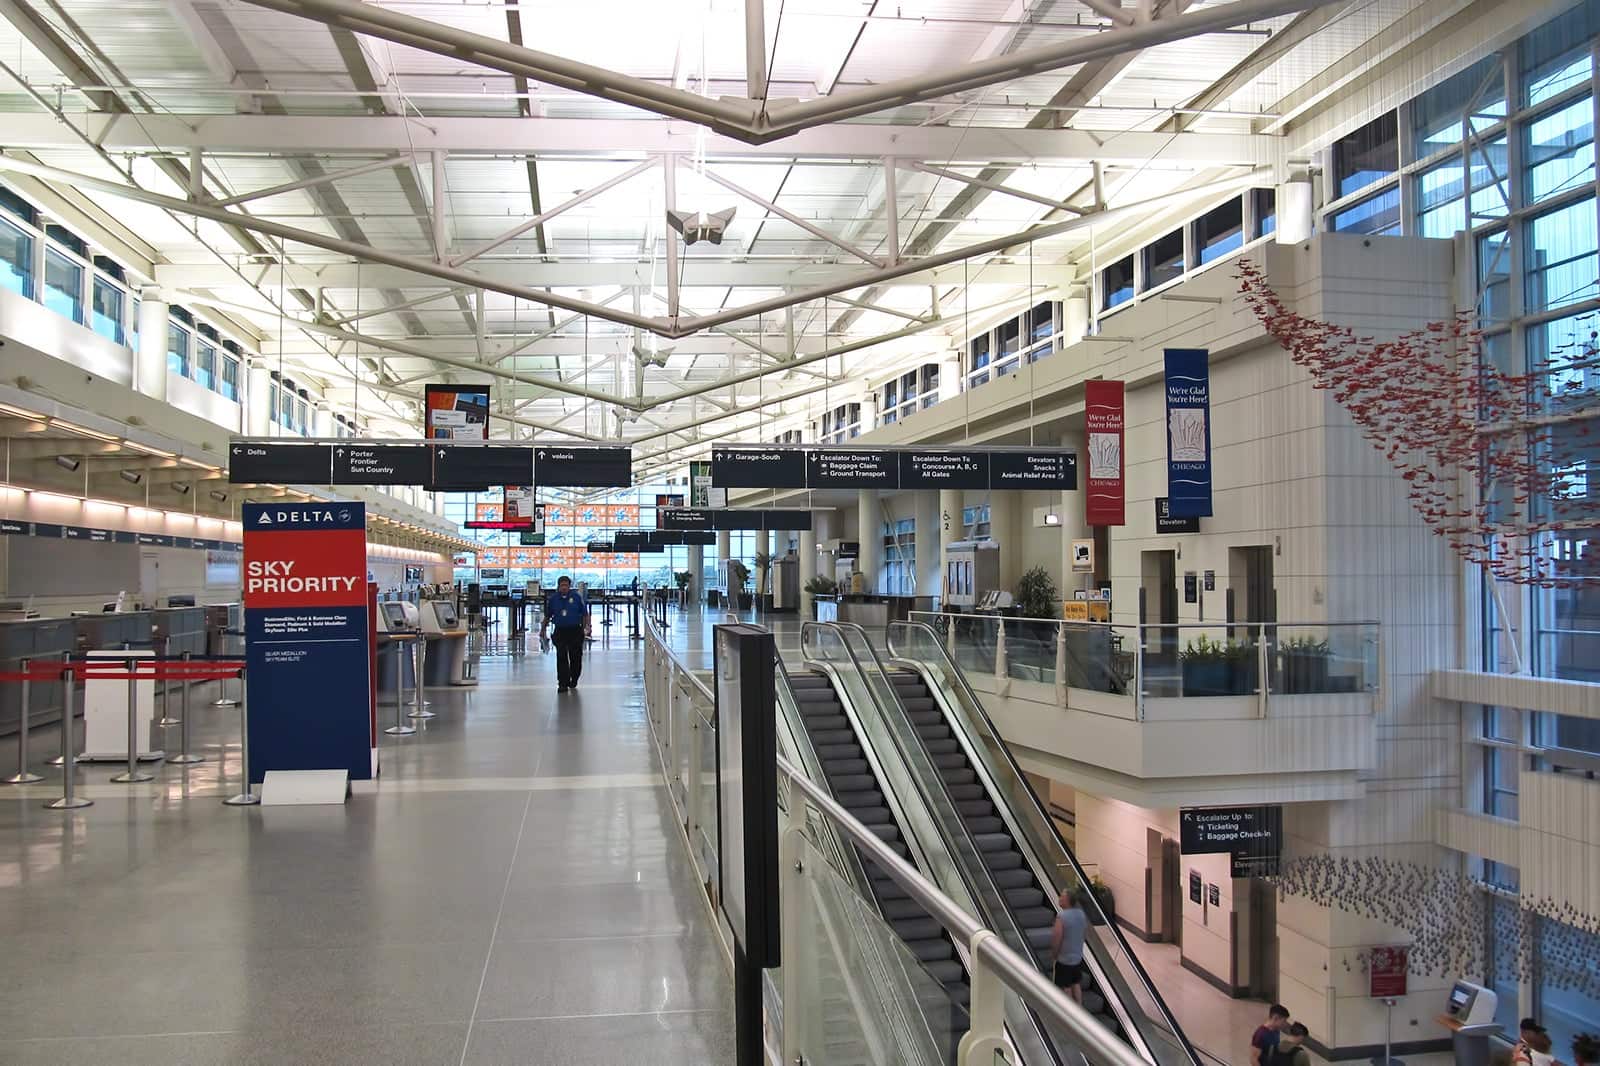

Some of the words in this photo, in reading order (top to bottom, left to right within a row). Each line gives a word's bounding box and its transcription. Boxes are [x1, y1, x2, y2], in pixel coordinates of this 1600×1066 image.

[1169, 387, 1187, 395] We're
[1190, 387, 1206, 395] Glad
[1168, 396, 1188, 404] You're
[1189, 396, 1208, 404] Here!
[736, 454, 780, 462] Garage-South
[366, 466, 394, 474] Country
[277, 511, 334, 523] DELTA
[248, 561, 295, 577] SKY
[248, 576, 356, 593] PRIORITY
[1232, 814, 1242, 822] Up
[1207, 823, 1239, 831] Ticketing
[1207, 833, 1238, 841] Baggage
